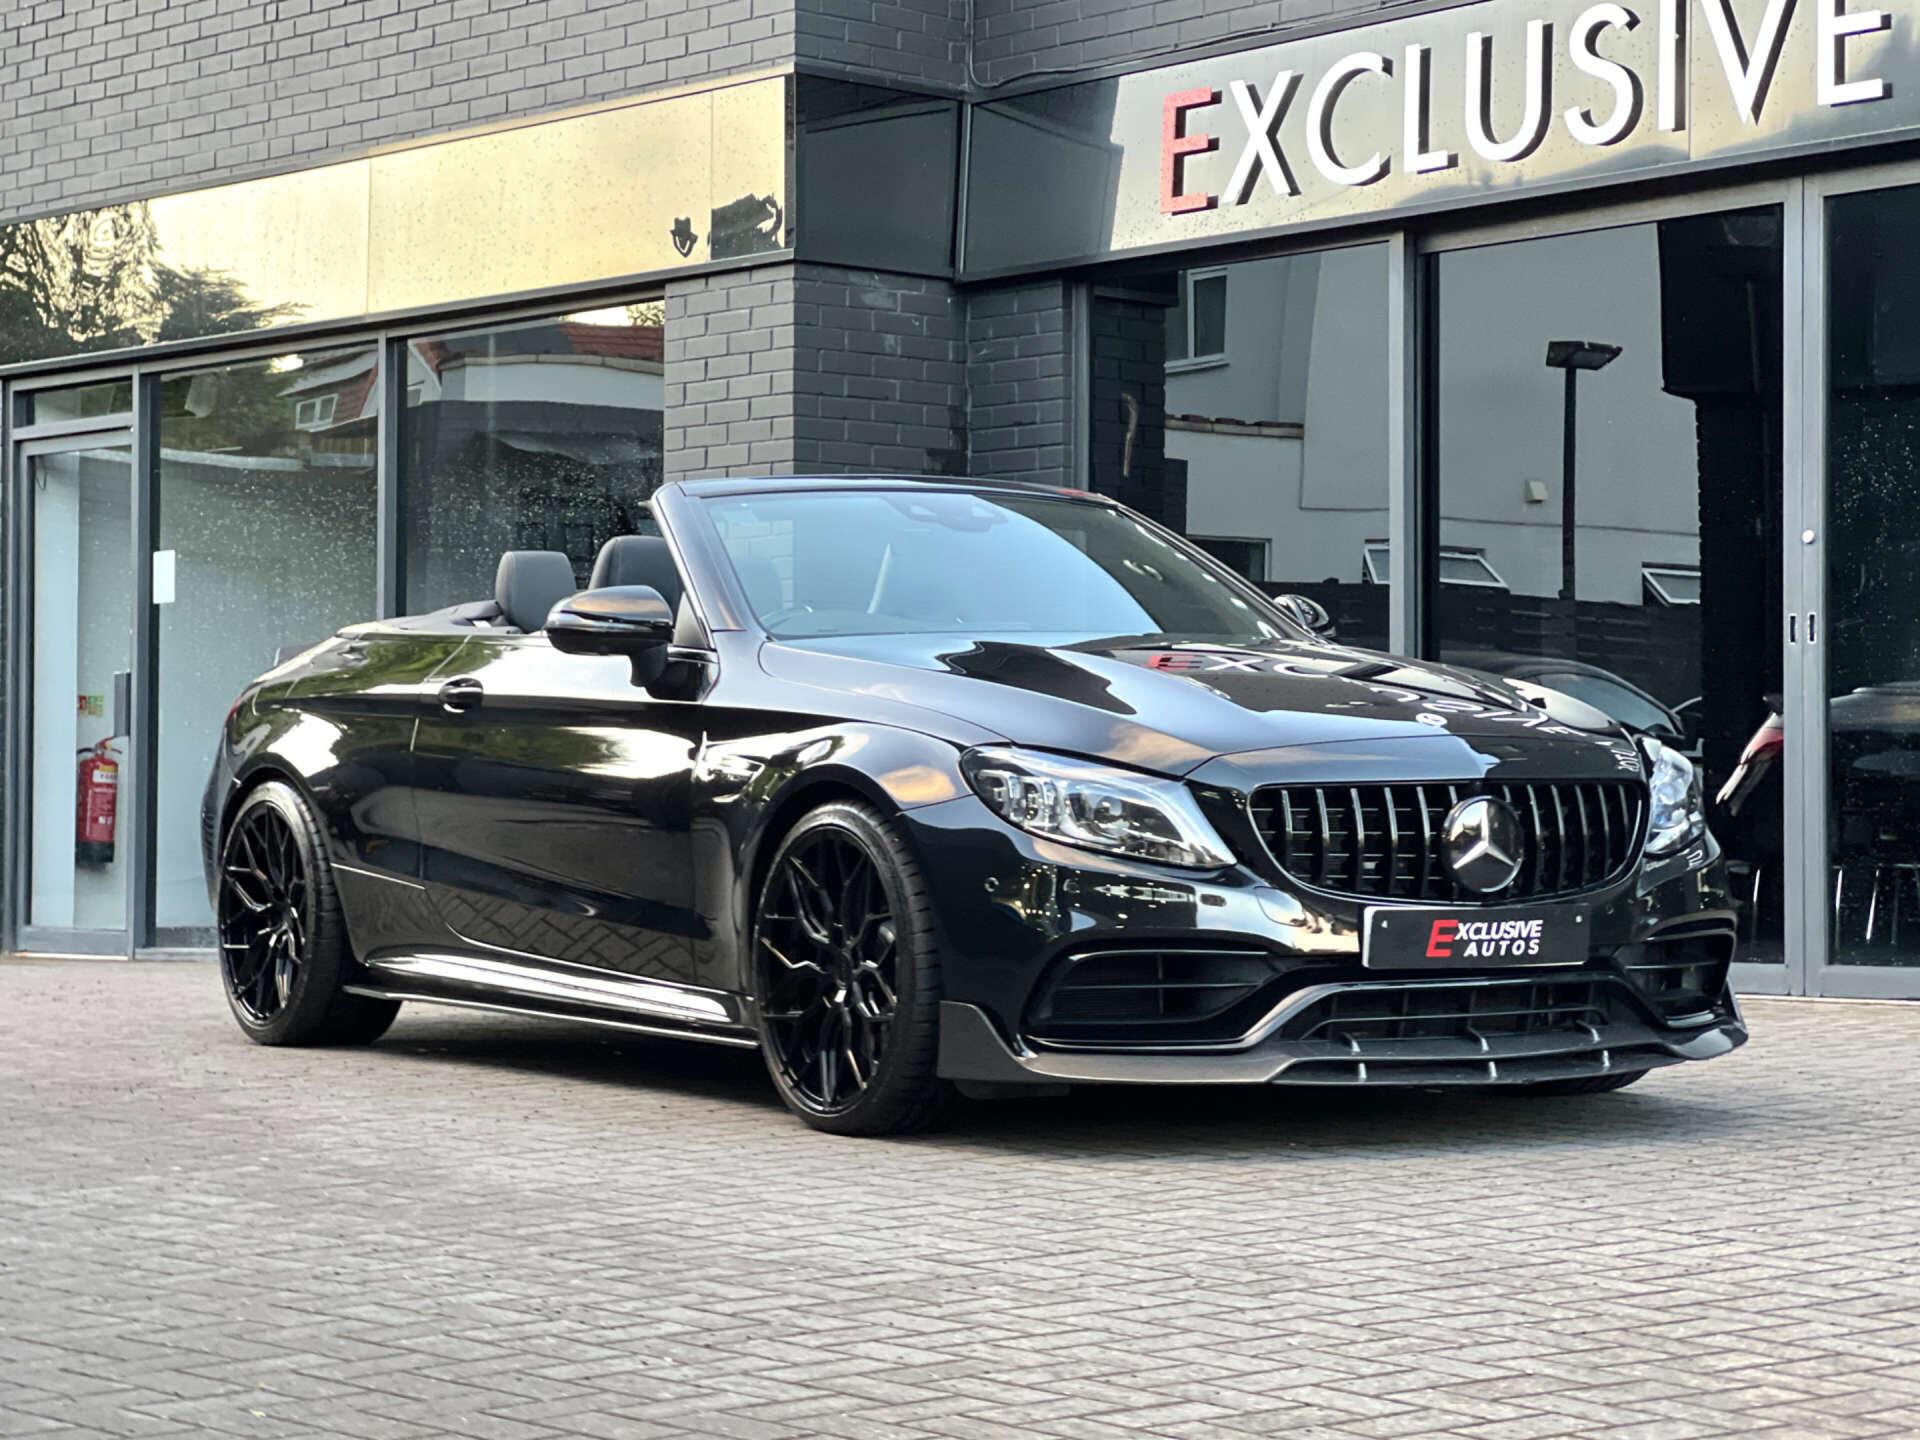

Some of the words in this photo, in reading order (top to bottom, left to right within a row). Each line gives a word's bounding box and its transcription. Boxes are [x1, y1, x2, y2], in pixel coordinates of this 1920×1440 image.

[1159, 0, 1888, 213] EXCLUSIVE
[1425, 919, 1544, 958] EXCLUSIVE
[1463, 938, 1540, 958] AUTOS
